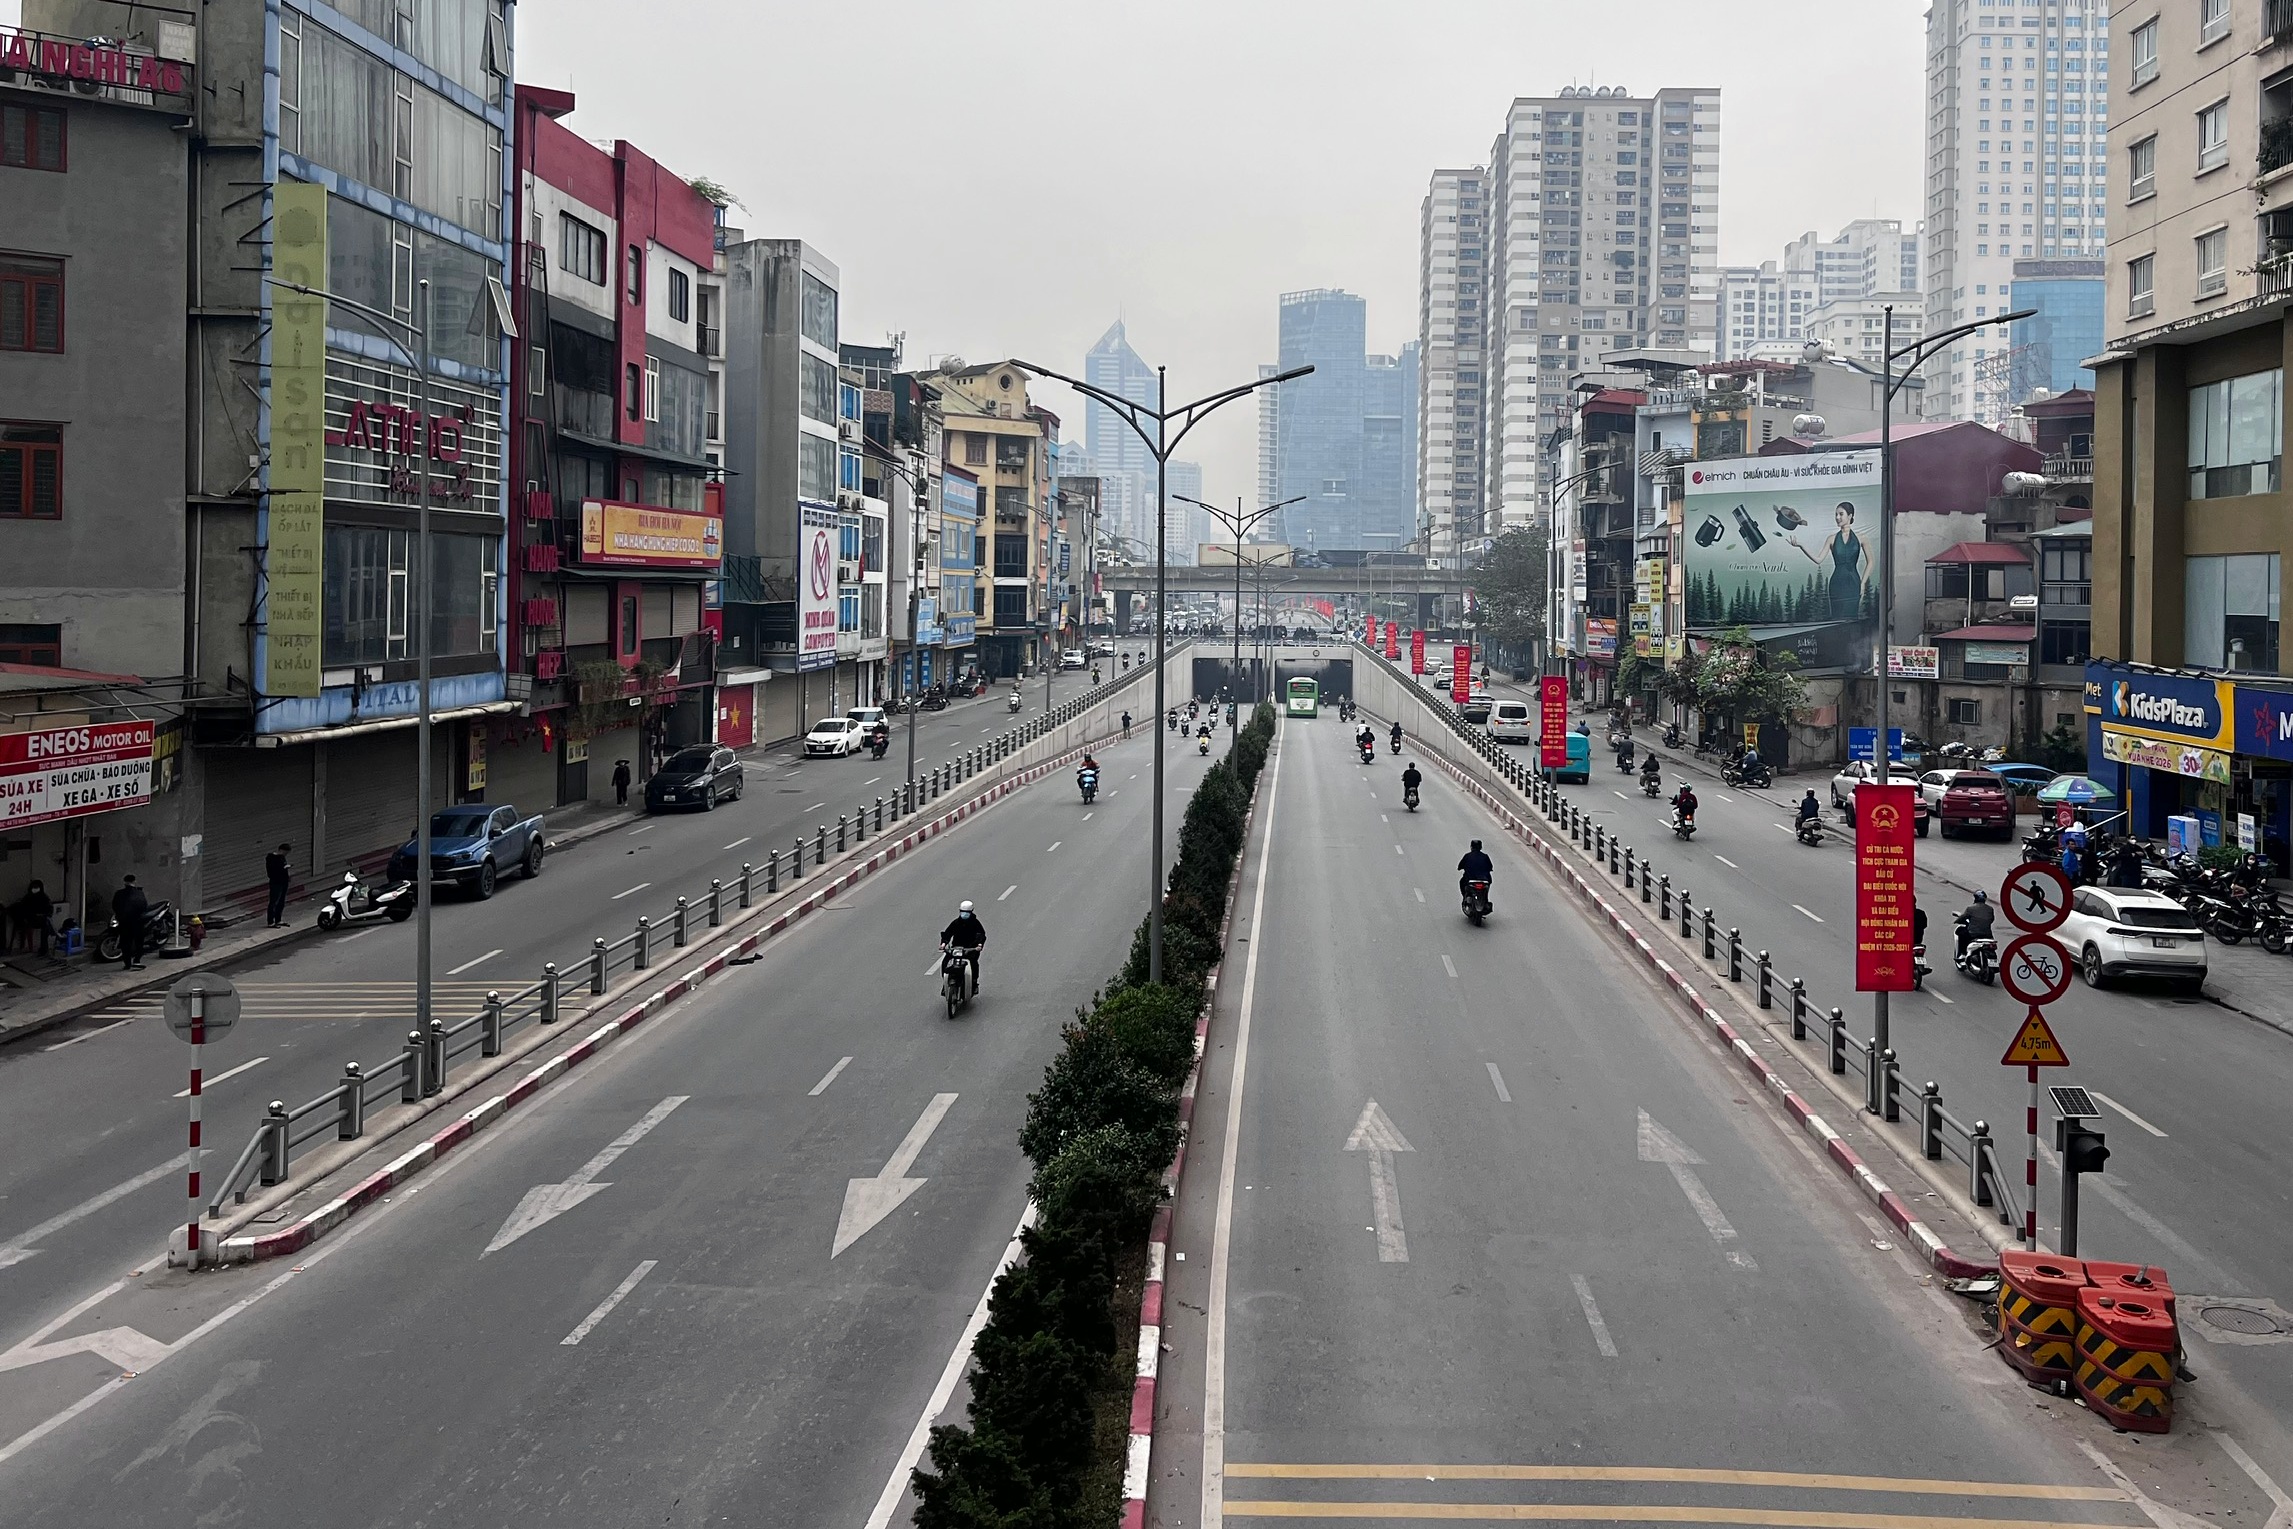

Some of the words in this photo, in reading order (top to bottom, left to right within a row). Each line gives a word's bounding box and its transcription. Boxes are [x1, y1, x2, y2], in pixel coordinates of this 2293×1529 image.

[42, 38, 129, 85] NGHỈ
[138, 56, 183, 93] A6
[1705, 470, 1737, 482] elmich
[1831, 464, 1841, 475] GIA
[805, 632, 836, 650] COMPUTER
[2130, 693, 2205, 728] KidsPlaza
[28, 729, 90, 758] ENEOS
[93, 734, 132, 749] MOTOR
[134, 730, 151, 744] OIL
[102, 763, 120, 780] BẢO
[2155, 757, 2172, 769] 2026
[27, 779, 43, 794] XE
[63, 790, 79, 808] XE
[82, 788, 97, 804] GA
[107, 783, 121, 801] XE
[124, 776, 140, 797] SỐ
[8, 799, 32, 816] 24H
[2020, 1036, 2051, 1050] 4.75m
